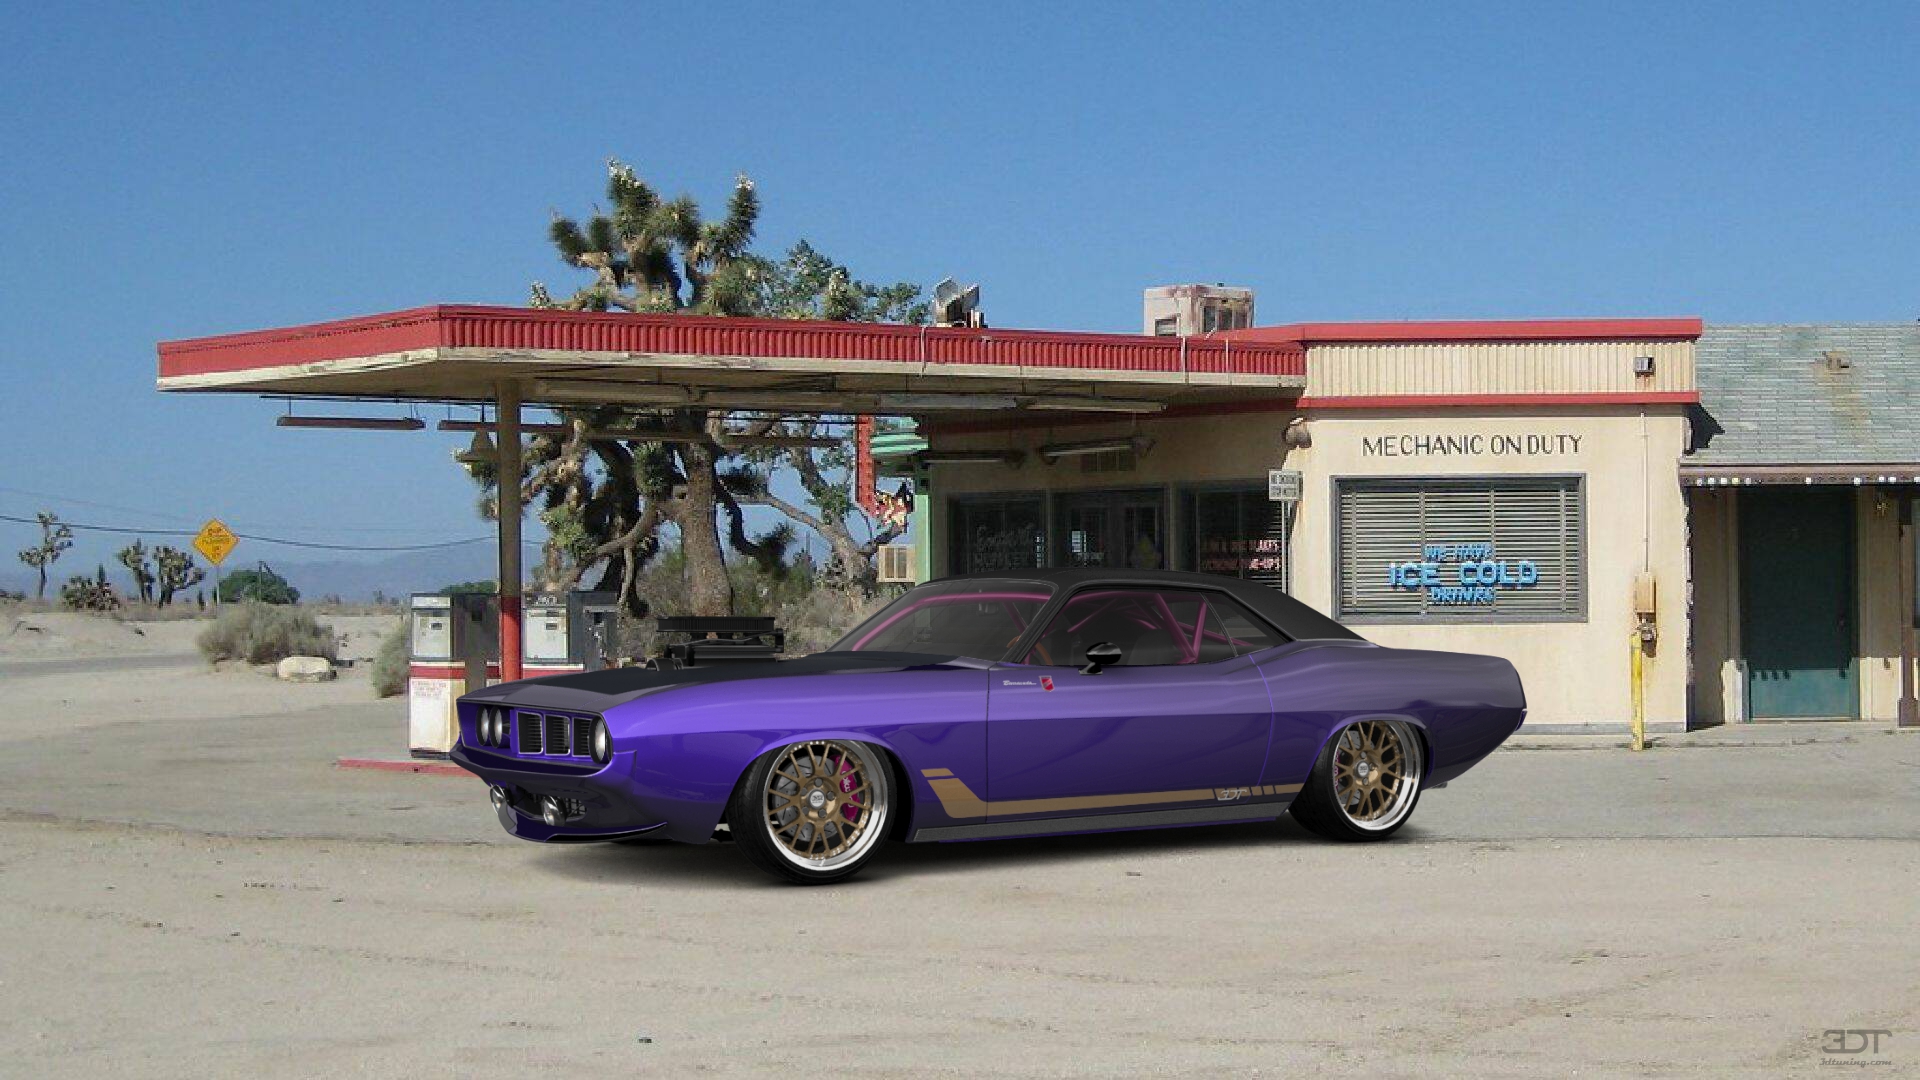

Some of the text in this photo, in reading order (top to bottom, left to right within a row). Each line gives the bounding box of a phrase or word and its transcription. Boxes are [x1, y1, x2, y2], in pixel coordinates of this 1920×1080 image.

[1362, 434, 1583, 457] MECHANIC ON DUTY
[1389, 561, 1538, 587] ICE COLD
[1217, 788, 1248, 802] 3DT
